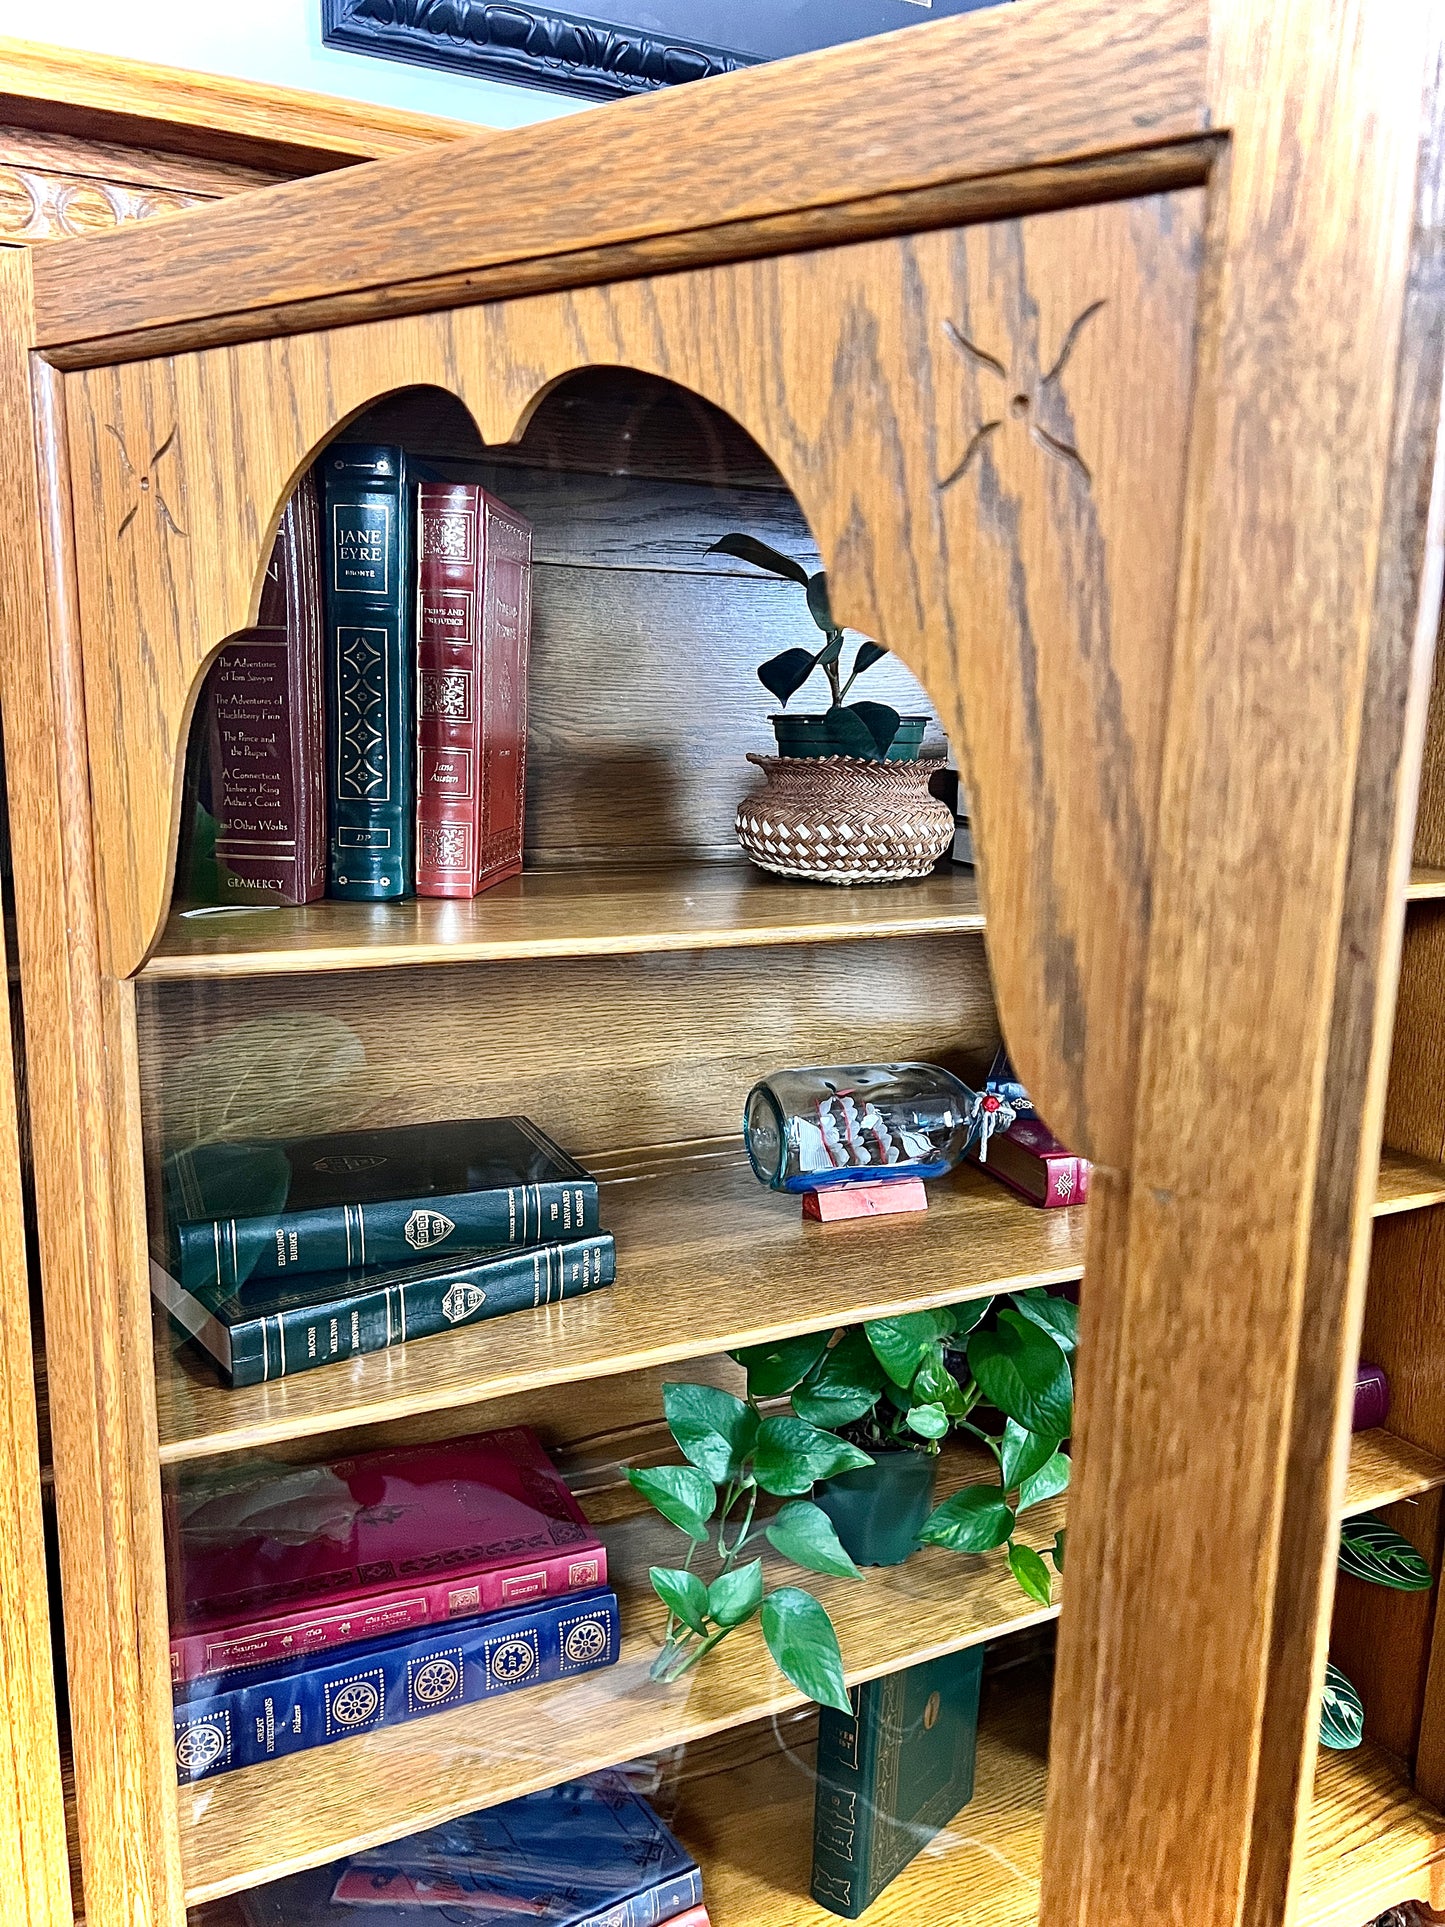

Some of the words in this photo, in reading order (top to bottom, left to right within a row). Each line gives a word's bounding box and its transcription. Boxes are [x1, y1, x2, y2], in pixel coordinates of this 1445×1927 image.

[338, 529, 382, 546] JANE
[340, 547, 382, 561] EYRE
[447, 608, 464, 617] AND
[218, 656, 232, 668] The
[234, 658, 276, 668] Adventures
[220, 672, 229, 681] of
[232, 671, 246, 681] Tom
[247, 671, 273, 684] Sawyer
[215, 694, 228, 704] The
[230, 694, 272, 705] Adventures
[274, 695, 283, 705] of
[218, 708, 260, 722] Huckleberry
[262, 708, 280, 720] Finn
[223, 731, 236, 742] The
[238, 732, 258, 742] Prince
[260, 733, 276, 743] and
[230, 745, 242, 756] the
[244, 745, 267, 759] Pauper
[434, 762, 454, 772] Jane
[222, 768, 230, 779] A
[232, 768, 280, 780] Connecticut
[430, 773, 458, 783] Austen
[224, 782, 248, 793] Yankee
[249, 785, 257, 793] in
[260, 783, 280, 795] King
[223, 796, 252, 807] Arthur's
[254, 796, 281, 807] Court
[220, 819, 232, 829] and
[233, 818, 256, 831] Other
[258, 820, 288, 831] Works
[227, 878, 284, 889] GRAMERCY
[563, 1190, 571, 1230] HARVARD
[575, 1190, 584, 1227] CLASSICS
[276, 1228, 286, 1266] EDMUND
[289, 1231, 298, 1261] BURKE
[351, 1311, 360, 1350] BROWNE
[308, 1326, 316, 1358] BACON
[509, 1655, 517, 1668] DP
[265, 1698, 274, 1752] EXPECTATIONS
[292, 1705, 301, 1733] Dickens
[256, 1717, 264, 1743] GREAT
